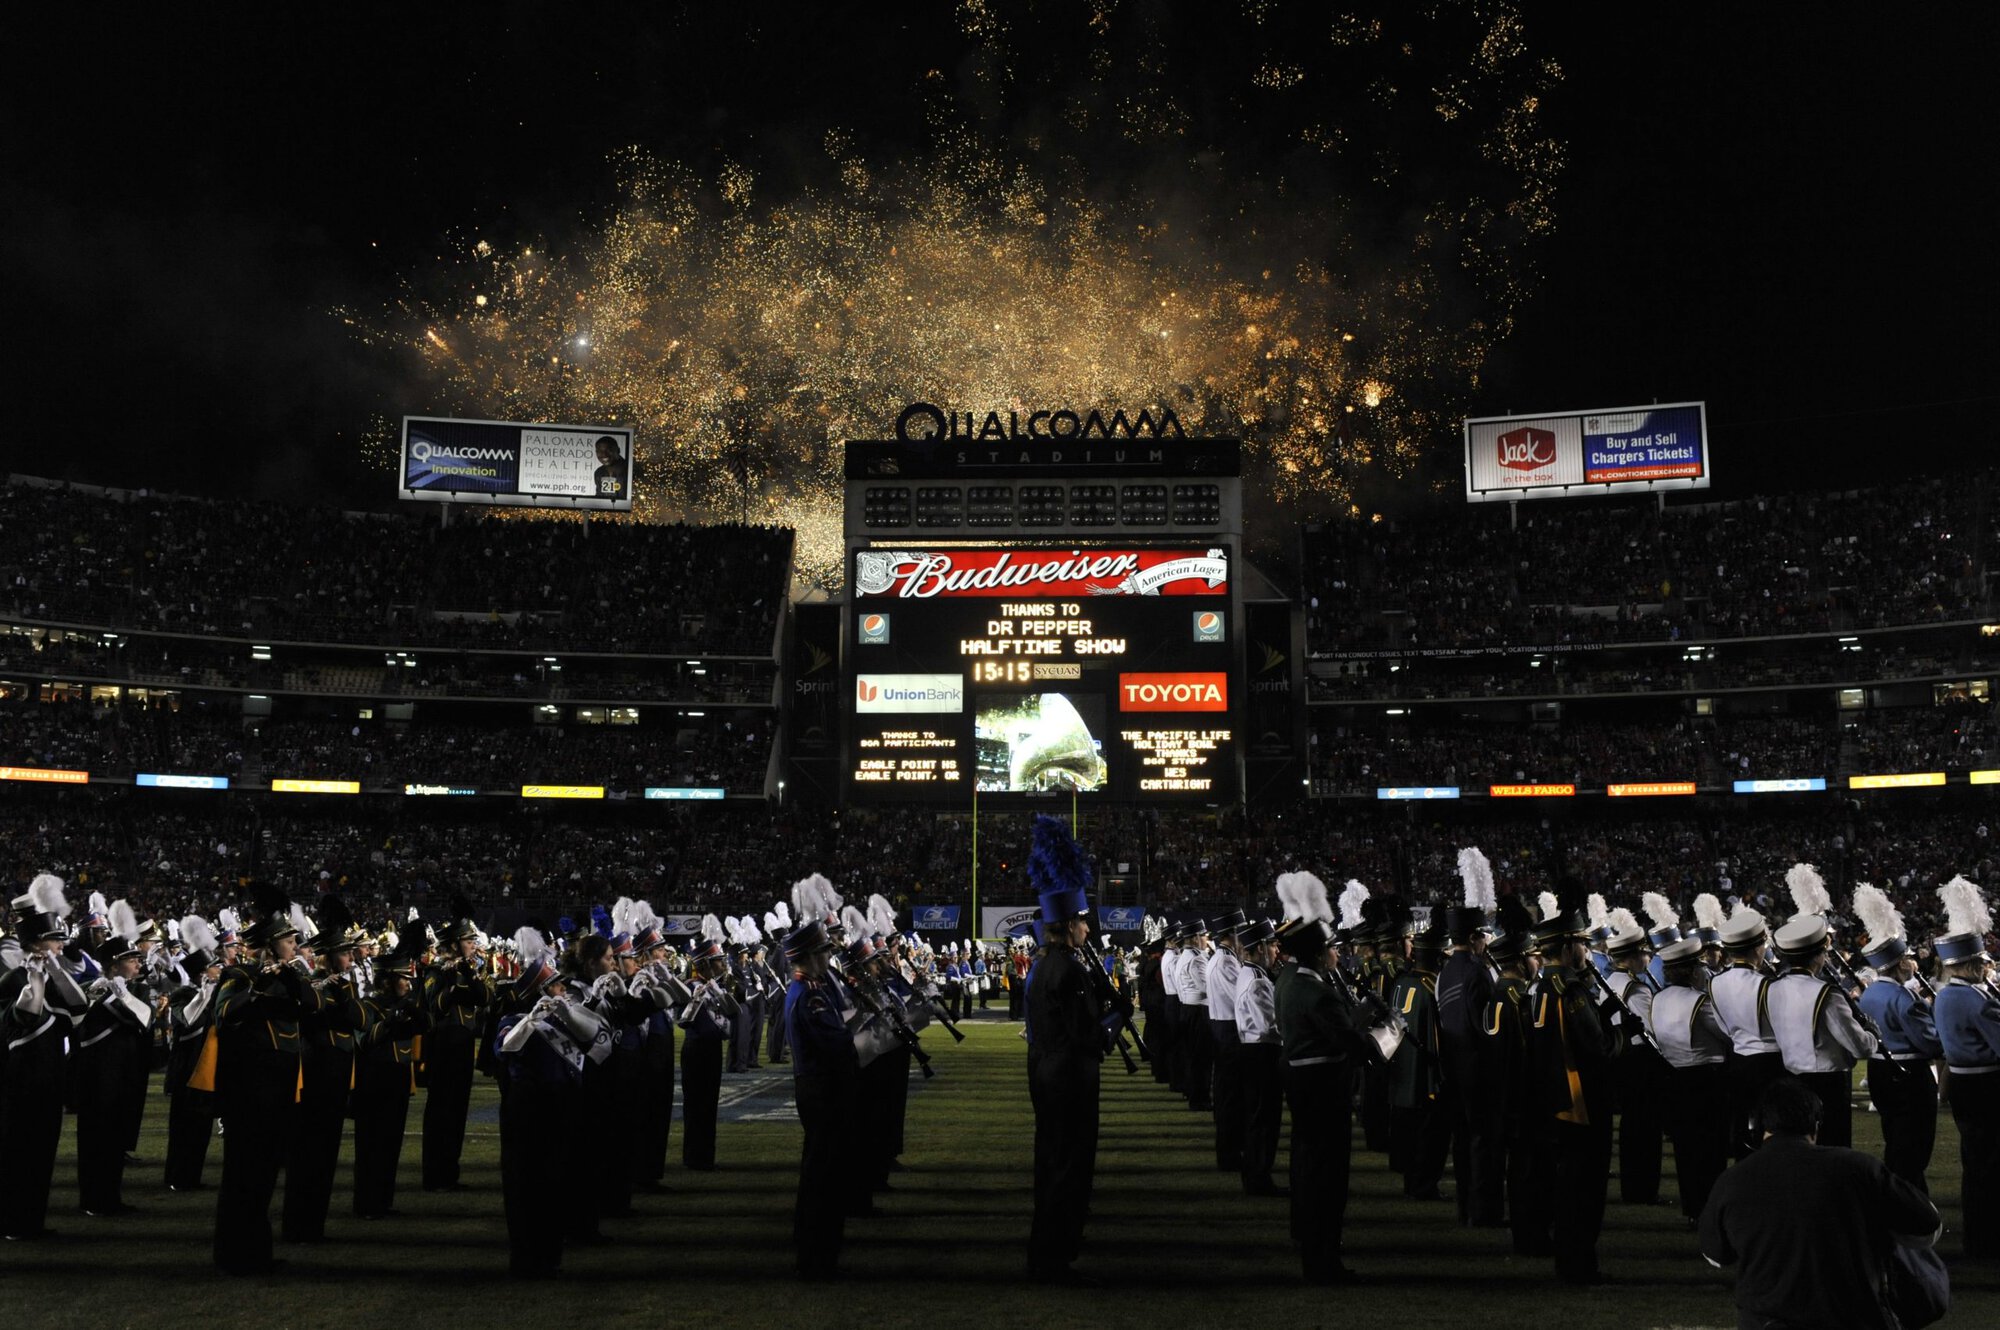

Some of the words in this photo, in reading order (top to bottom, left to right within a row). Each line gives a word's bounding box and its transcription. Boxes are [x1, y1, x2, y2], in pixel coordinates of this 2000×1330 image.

[896, 402, 1187, 442] QUALCOMM
[526, 434, 593, 448] PALOMAR
[1606, 437, 1627, 450] Buy
[1630, 435, 1652, 447] and
[1655, 433, 1677, 446] Sell
[412, 441, 514, 463] QUALCOMM
[525, 447, 593, 459] POMERADO
[1500, 431, 1554, 466] Jack
[957, 450, 1163, 463] STADIUM
[1591, 449, 1645, 465] Chargers
[1647, 446, 1694, 462] Tickets!
[432, 464, 496, 477] Innovation
[524, 459, 593, 471] HEALTH
[1513, 474, 1531, 483] the
[1534, 471, 1553, 482] box
[1590, 467, 1697, 480] NFL.COM/TICKETEXCHANGE
[530, 482, 586, 493] www.pph.org
[888, 549, 1138, 598] Budweiser
[1141, 566, 1190, 589] American
[1193, 563, 1224, 576] Lager
[1001, 604, 1055, 617] THANKS
[1061, 604, 1080, 616] TO
[988, 620, 1014, 636] DR
[1022, 620, 1092, 636] PEPPER
[960, 639, 1062, 655] HALFTIME
[1074, 639, 1126, 655] SHOW
[974, 662, 1030, 681] 15:15
[1034, 666, 1080, 676] SYCUAN
[795, 679, 835, 695] Sprint
[1124, 683, 1222, 702] TOYOTA
[884, 688, 961, 701] UnionBank
[881, 731, 919, 739] THANKS
[1121, 731, 1143, 740] THE
[1147, 731, 1197, 740] PACIFIC
[1201, 731, 1231, 740] LIFE
[1133, 740, 1183, 749] HOLIDAY
[1188, 740, 1217, 749] BOWL
[1155, 749, 1198, 758] THANKS
[860, 760, 896, 770] EAGLE
[901, 760, 937, 770] POINT
[942, 760, 957, 769] HS
[855, 771, 891, 780] EAGLE
[896, 771, 938, 780] POINT,
[944, 771, 960, 780] OR
[1164, 767, 1187, 777] WES
[1140, 779, 1212, 790] CARTWRIGHT
[1492, 786, 1532, 795] WELLS
[1534, 785, 1573, 795] FARGO
[1006, 914, 1033, 926] PACIFI
